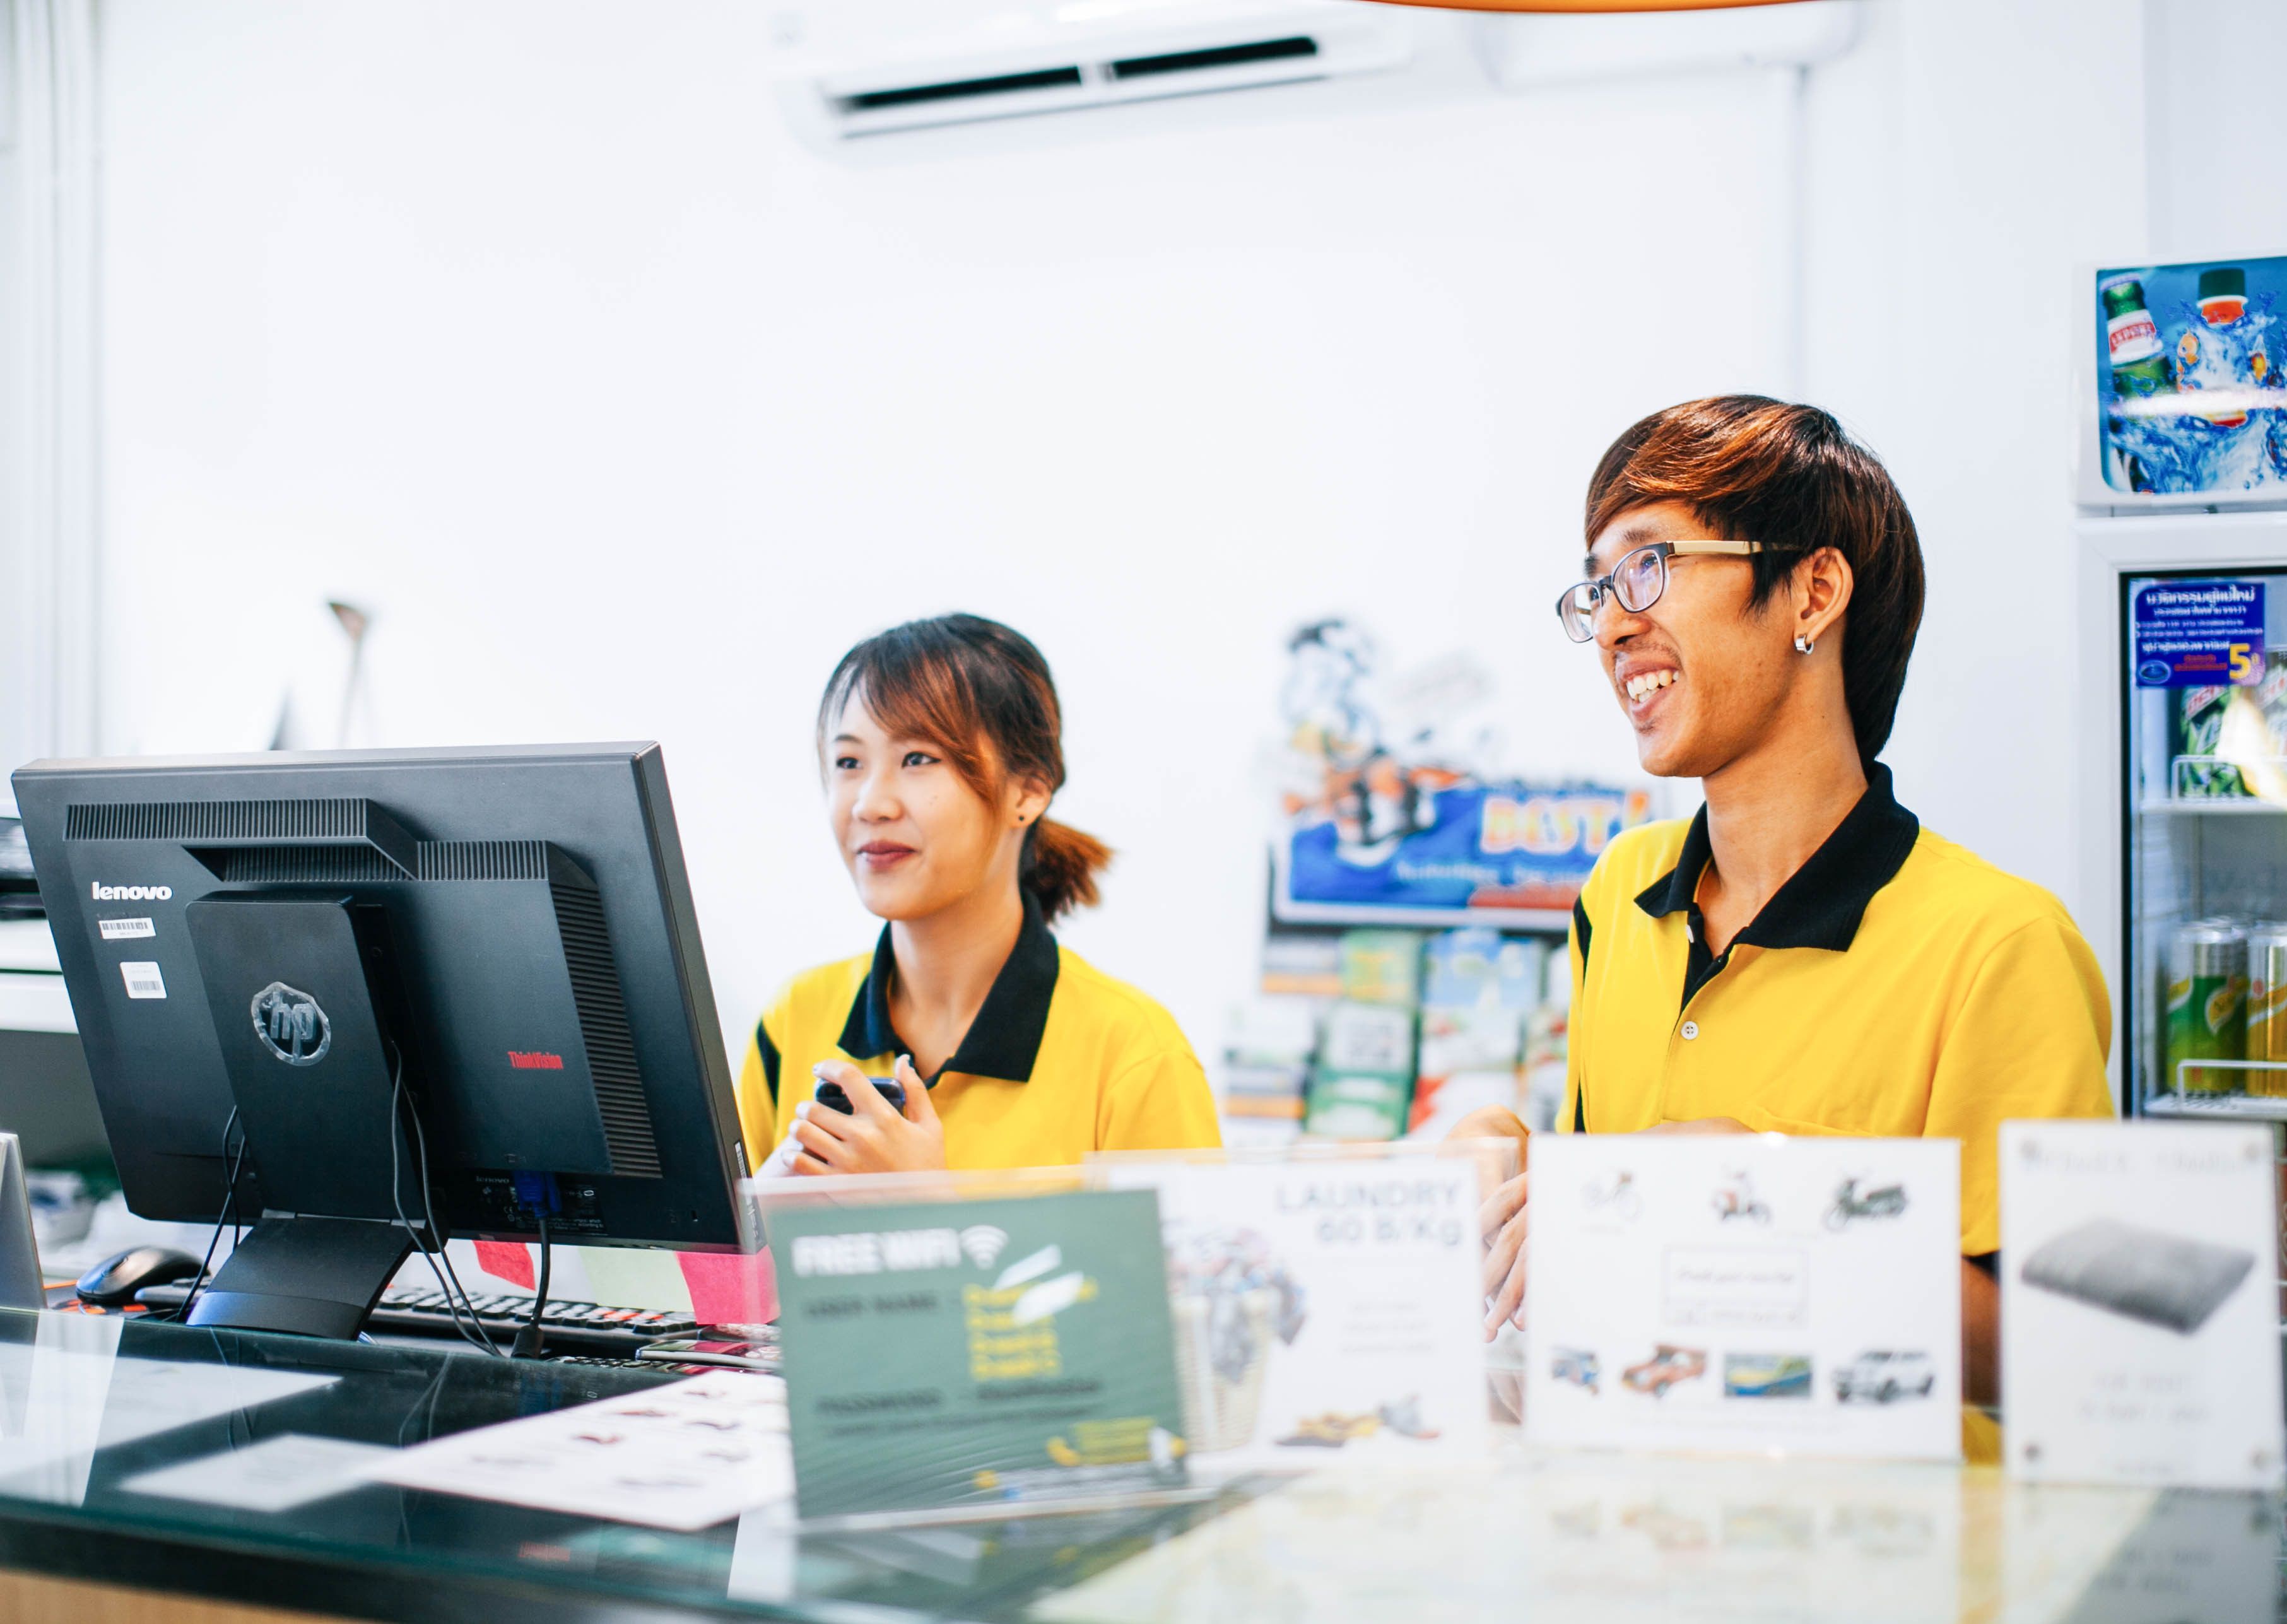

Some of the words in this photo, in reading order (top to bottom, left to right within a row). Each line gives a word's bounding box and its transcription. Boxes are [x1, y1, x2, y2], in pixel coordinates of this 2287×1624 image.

[2228, 643, 2252, 680] 5
[91, 881, 173, 900] lenovo
[270, 991, 315, 1061] hp
[507, 1050, 565, 1070] ThinkVision
[1274, 1182, 1464, 1213] LAUNDRY
[792, 1233, 881, 1278] FREE
[881, 1228, 961, 1271] WIFI
